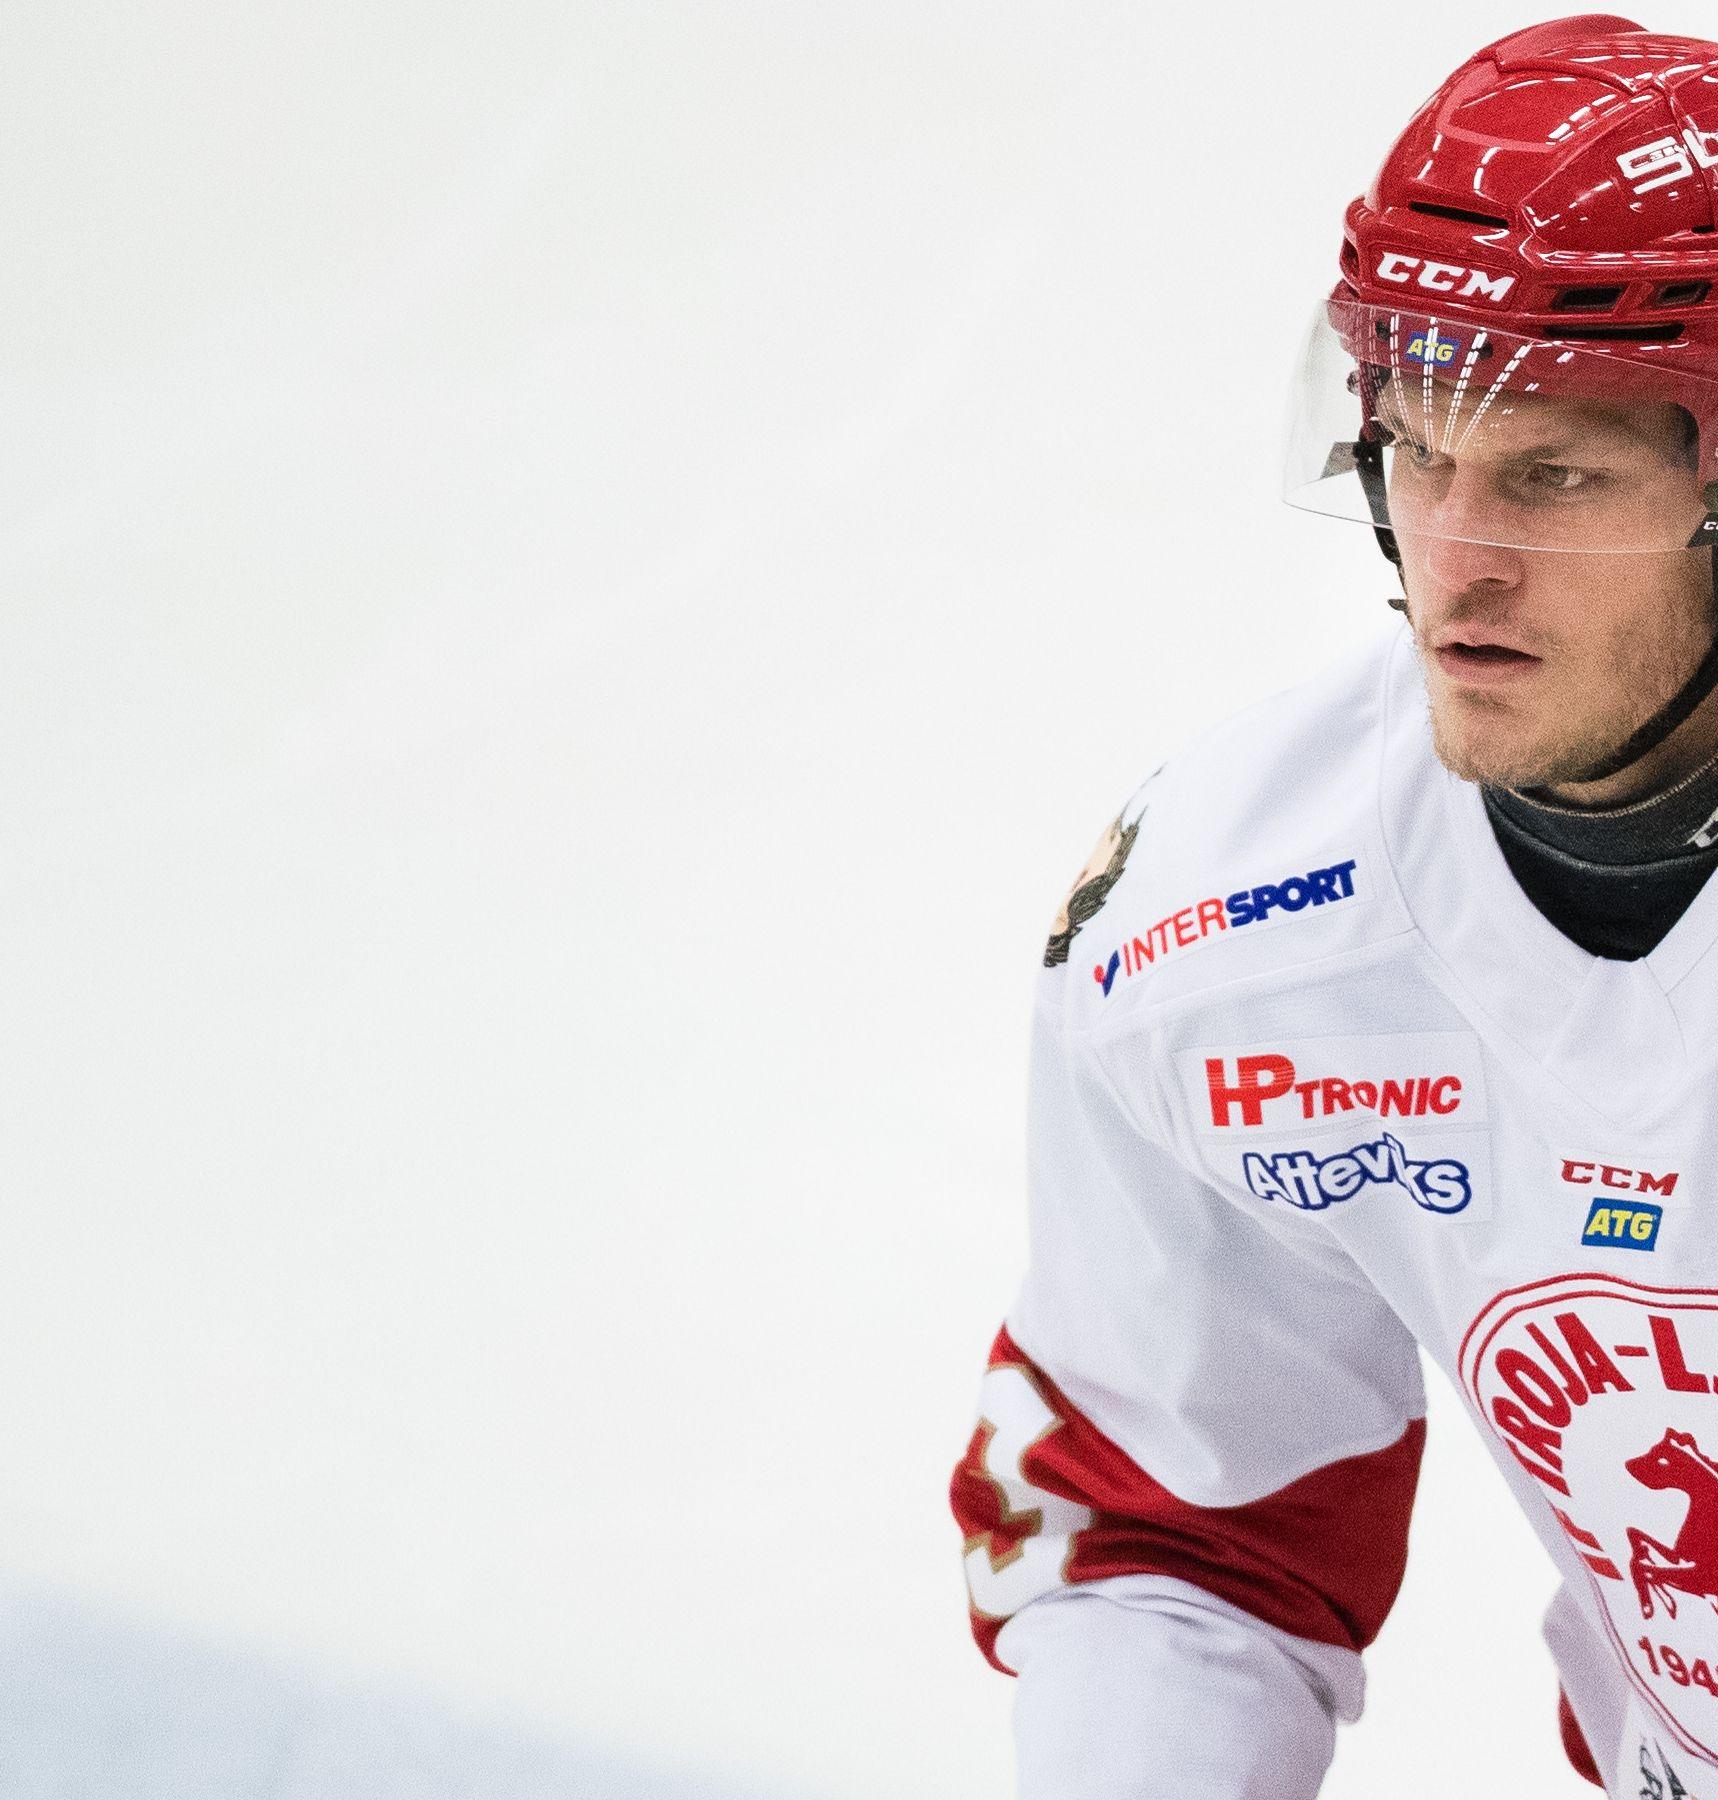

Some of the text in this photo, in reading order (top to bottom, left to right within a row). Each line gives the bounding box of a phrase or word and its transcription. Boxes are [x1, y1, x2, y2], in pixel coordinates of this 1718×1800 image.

[1376, 251, 1516, 302] CCM
[1122, 859, 1358, 978] INTERSPORT
[1560, 1158, 1680, 1197] CCM
[1584, 1207, 1656, 1242] ATG
